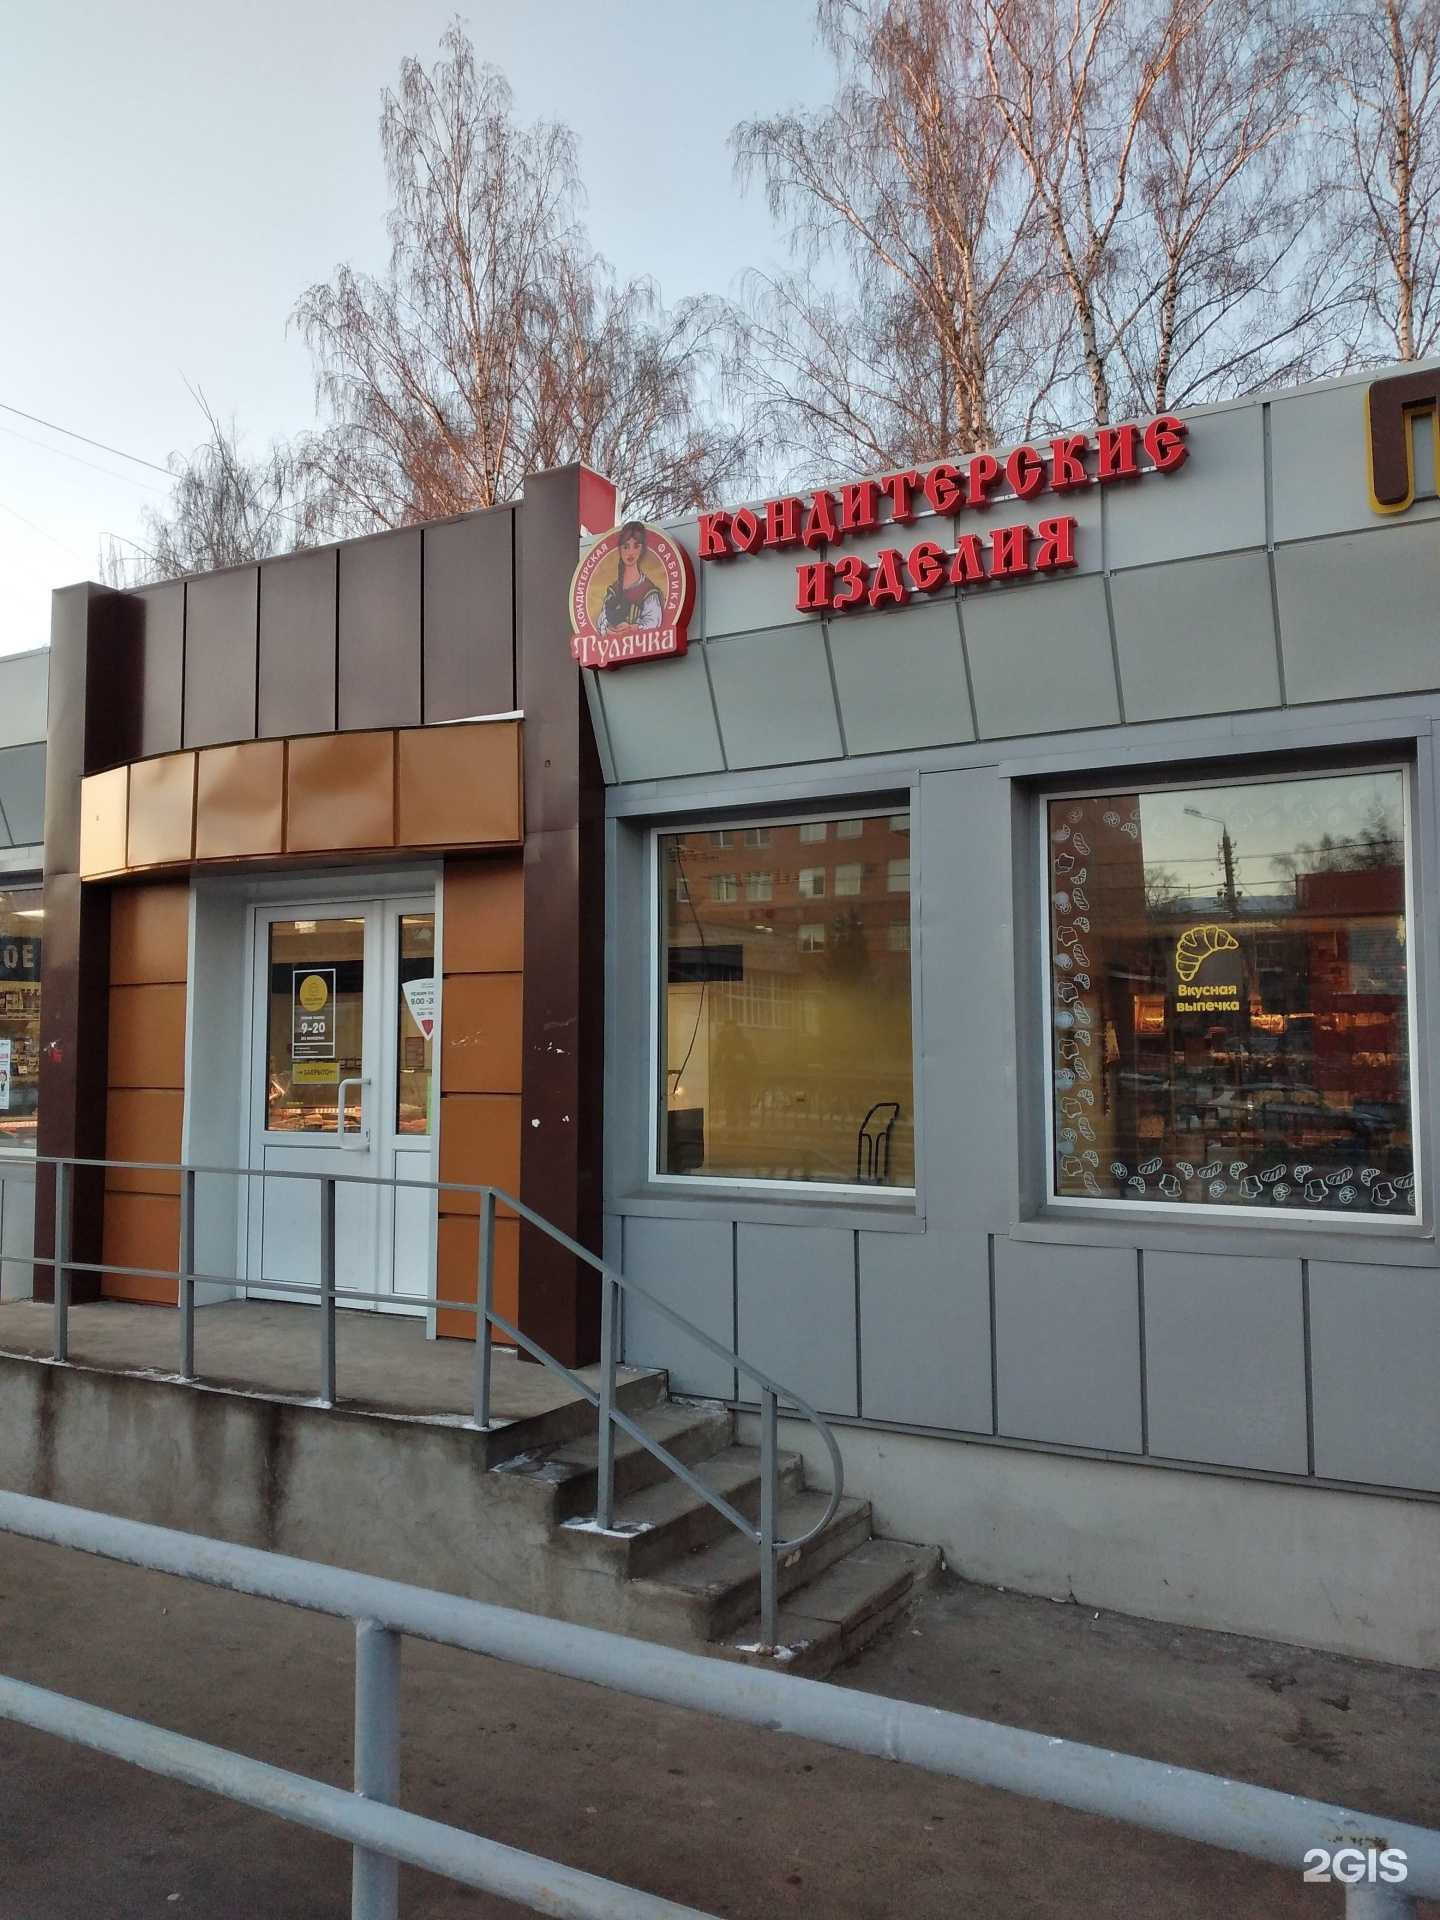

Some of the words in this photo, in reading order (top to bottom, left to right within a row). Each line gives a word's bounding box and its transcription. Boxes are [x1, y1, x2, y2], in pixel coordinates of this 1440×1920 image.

[697, 416, 1190, 560] КОНДИТЕРСКИЕ
[575, 543, 608, 628] КОНДИТЕРСКАЯ
[657, 543, 679, 610] ФАБРИКА
[795, 515, 1078, 612] ИЗДЕЛИЯ
[1176, 1001, 1240, 1012] выпечка
[1177, 985, 1237, 999] Вкусная
[301, 1022, 326, 1035] 9-20
